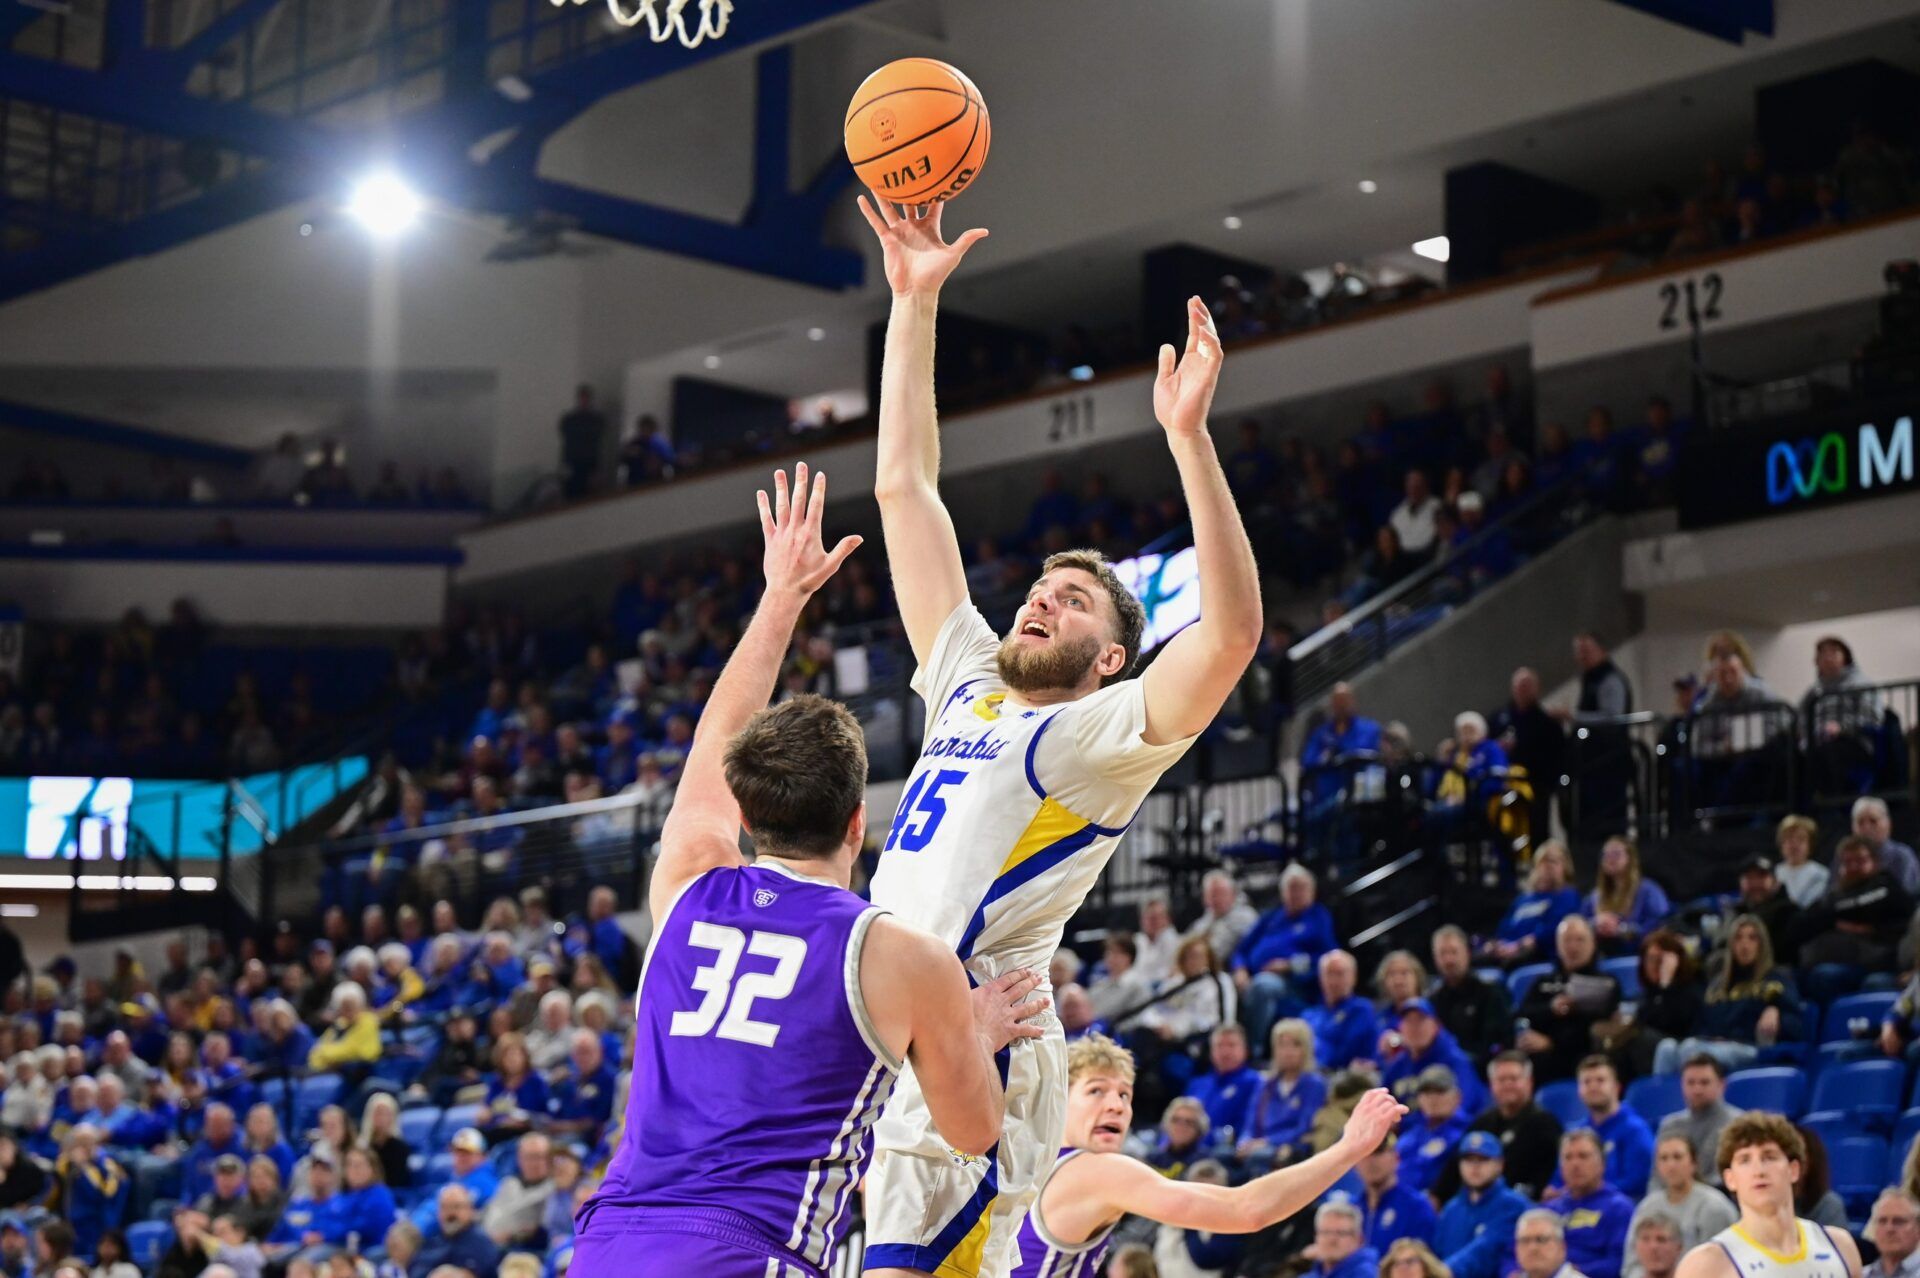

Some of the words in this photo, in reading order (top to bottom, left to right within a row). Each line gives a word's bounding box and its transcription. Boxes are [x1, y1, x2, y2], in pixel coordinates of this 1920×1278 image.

[1658, 272, 1724, 330] 212
[884, 768, 970, 853] 45
[669, 920, 808, 1048] 32
